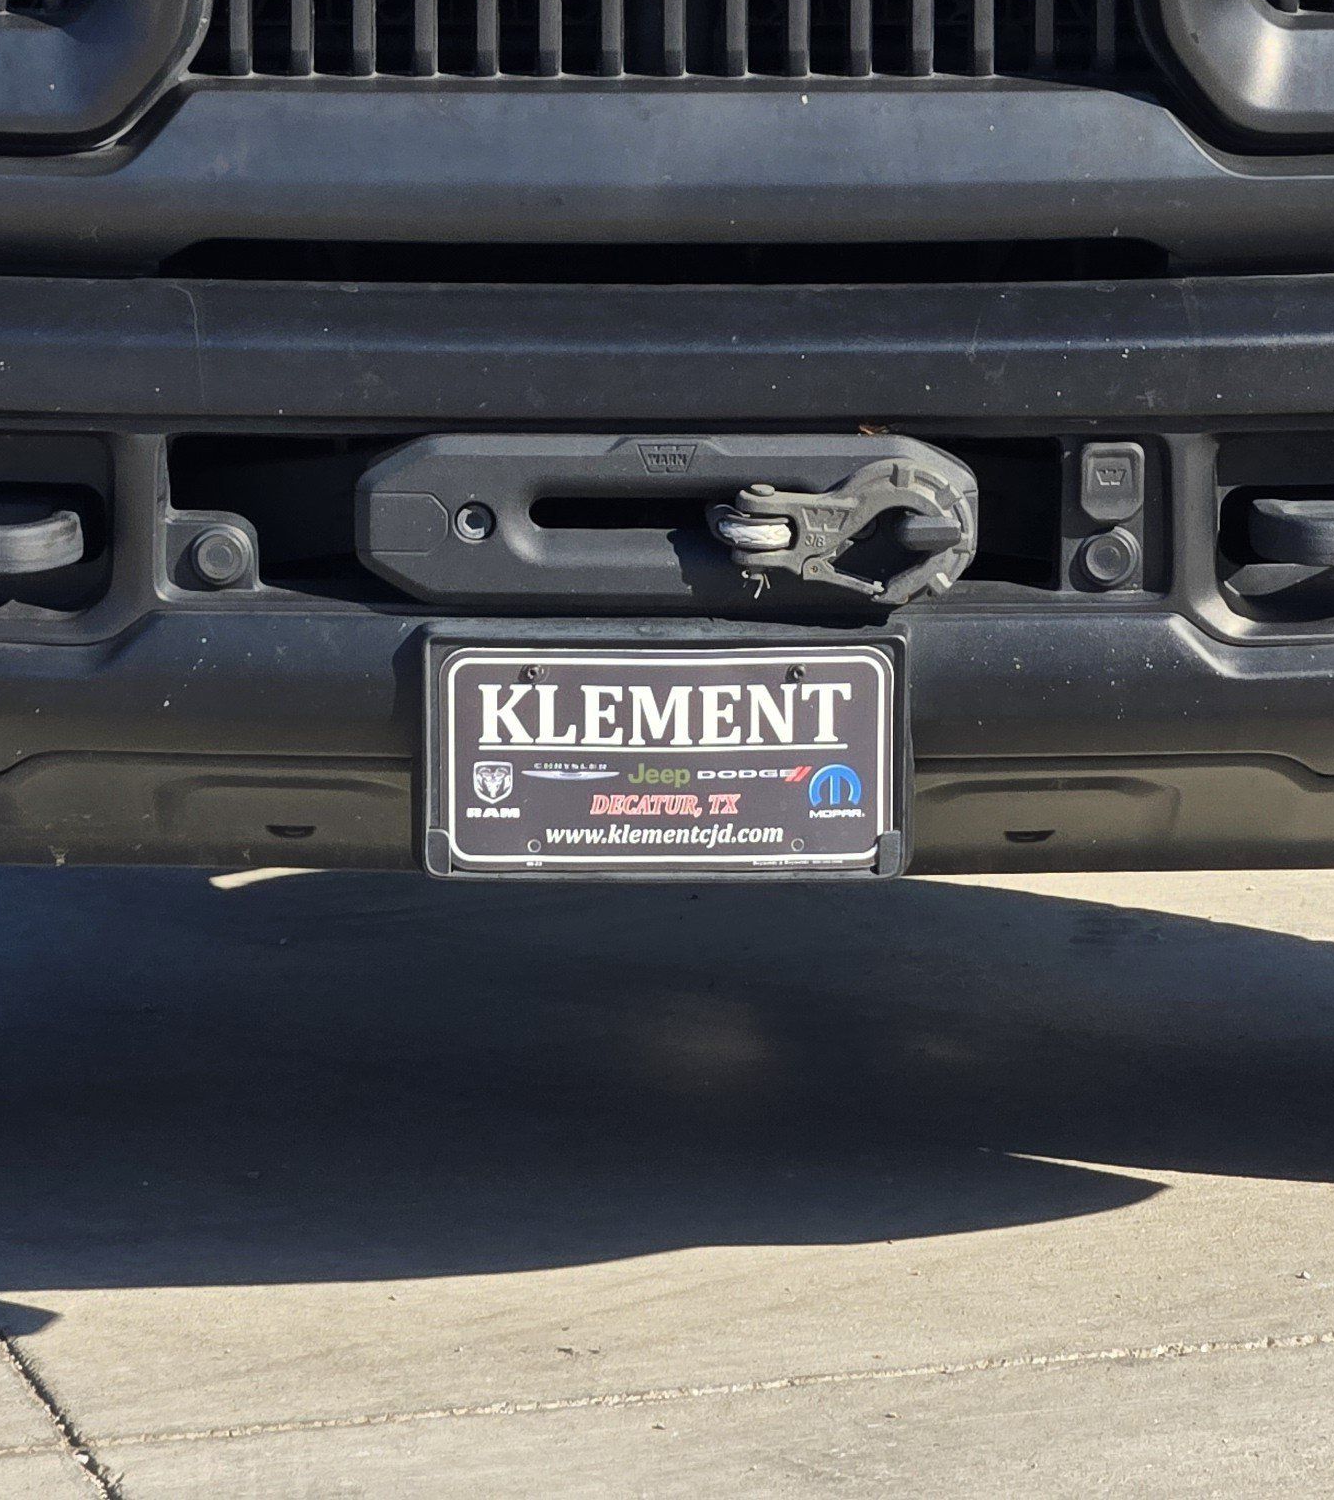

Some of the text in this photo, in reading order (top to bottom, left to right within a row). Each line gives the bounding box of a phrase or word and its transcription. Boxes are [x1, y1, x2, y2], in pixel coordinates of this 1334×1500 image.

[478, 683, 852, 746] KLEMENT
[628, 762, 691, 788] Jeep
[696, 768, 797, 780] DODGE
[467, 807, 520, 819] RAM
[590, 793, 741, 818] DECATUR, TX
[545, 823, 784, 849] www.klementcjd.com
